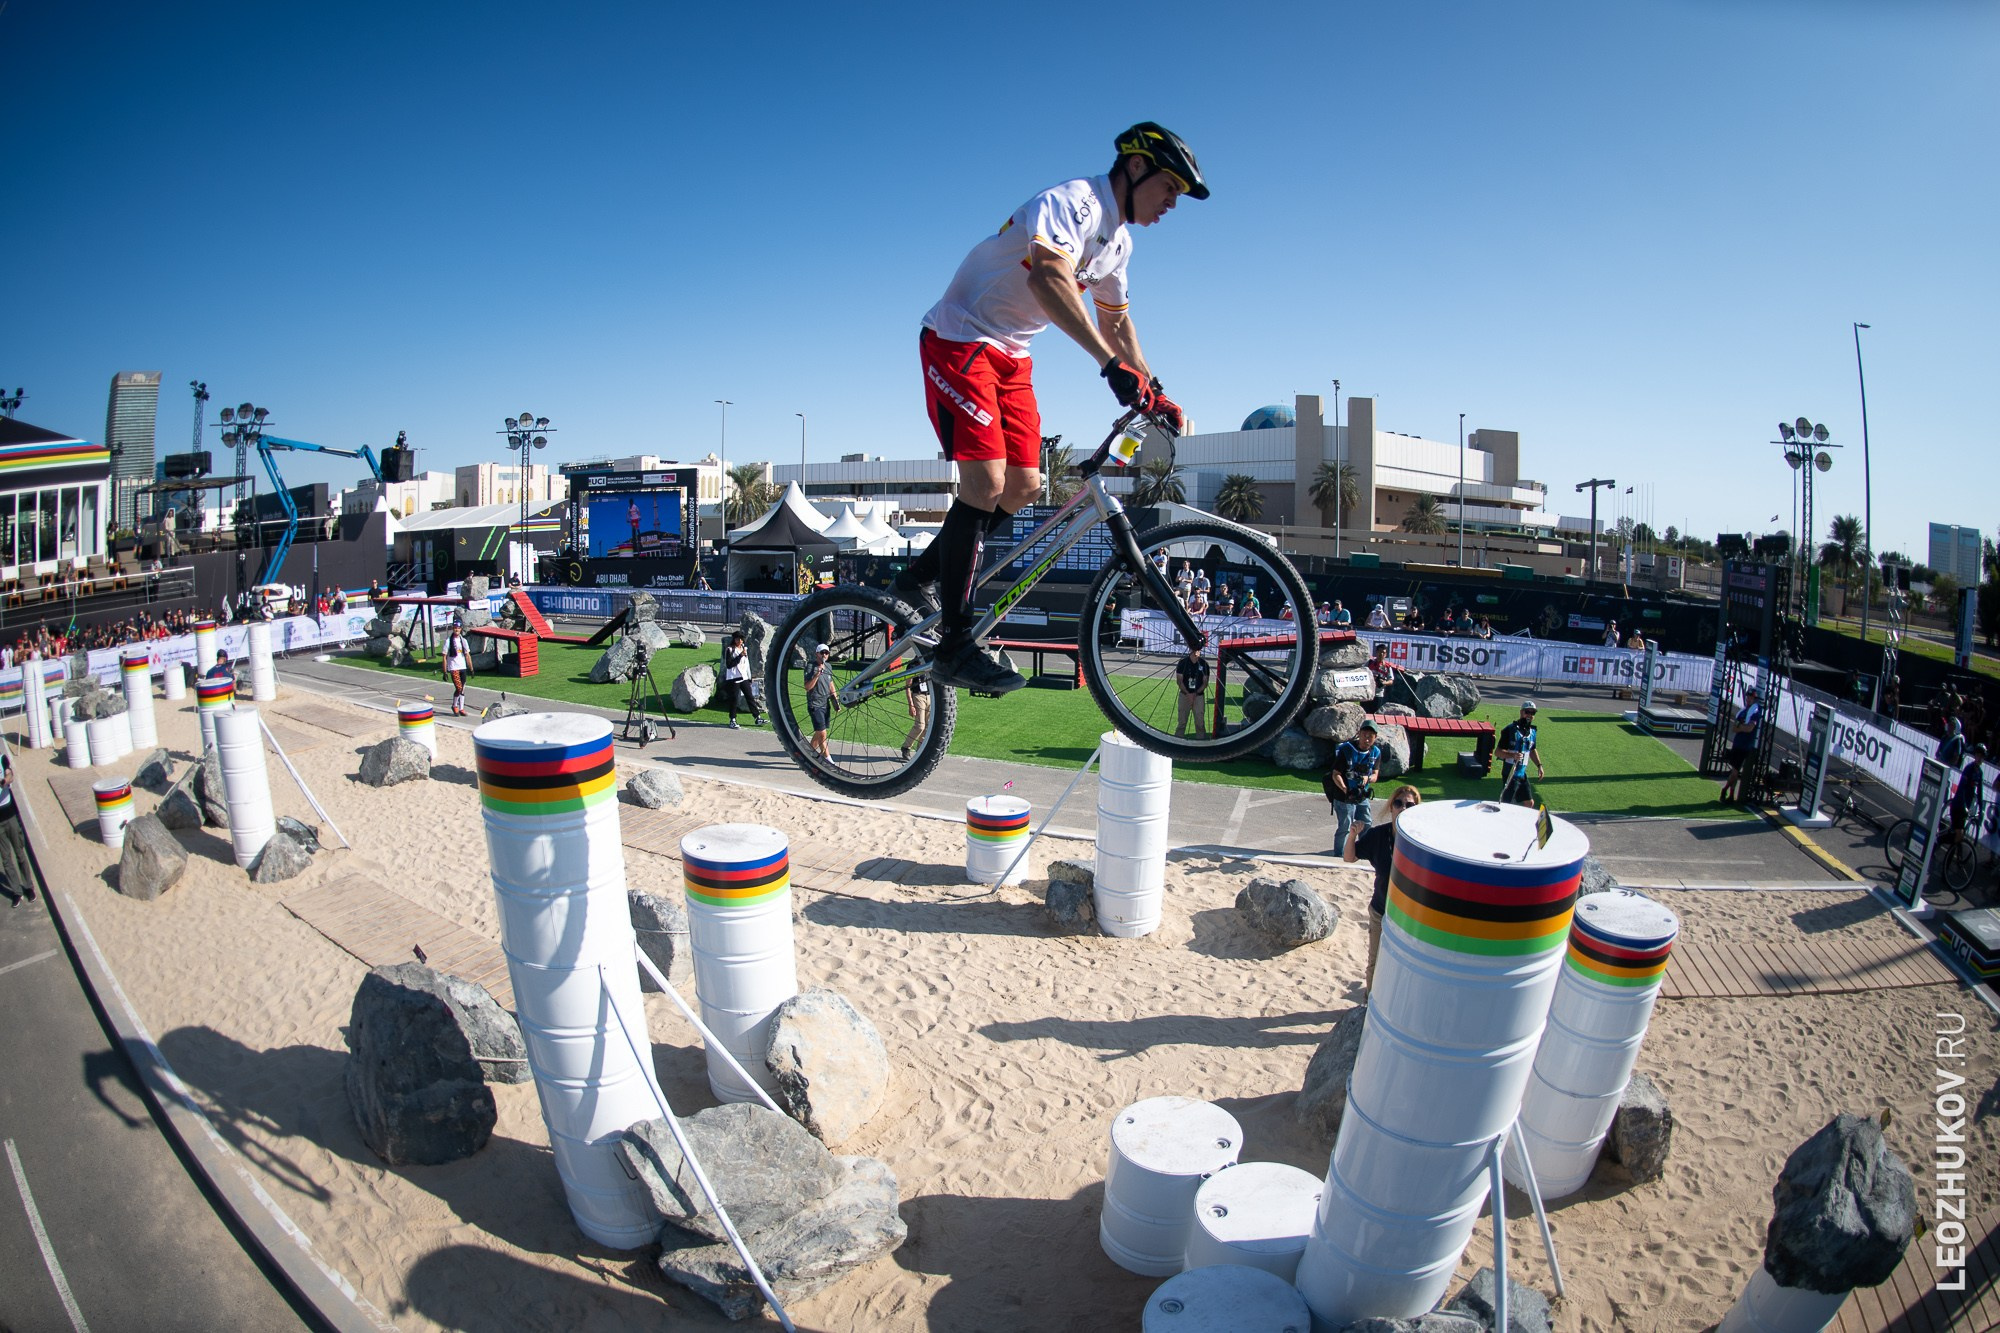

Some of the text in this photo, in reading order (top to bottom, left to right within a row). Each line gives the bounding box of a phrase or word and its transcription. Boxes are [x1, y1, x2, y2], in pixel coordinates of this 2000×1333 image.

[928, 365, 994, 427] COMAS
[592, 477, 605, 485] UCI
[596, 574, 628, 584] ABU DHABI
[542, 596, 600, 611] SHIMANO
[1411, 643, 1507, 668] TISSOT
[1675, 723, 1691, 732] UCI
[1831, 721, 1892, 769] TISSOT
[1920, 781, 1939, 799] START
[1918, 796, 1931, 825] 2
